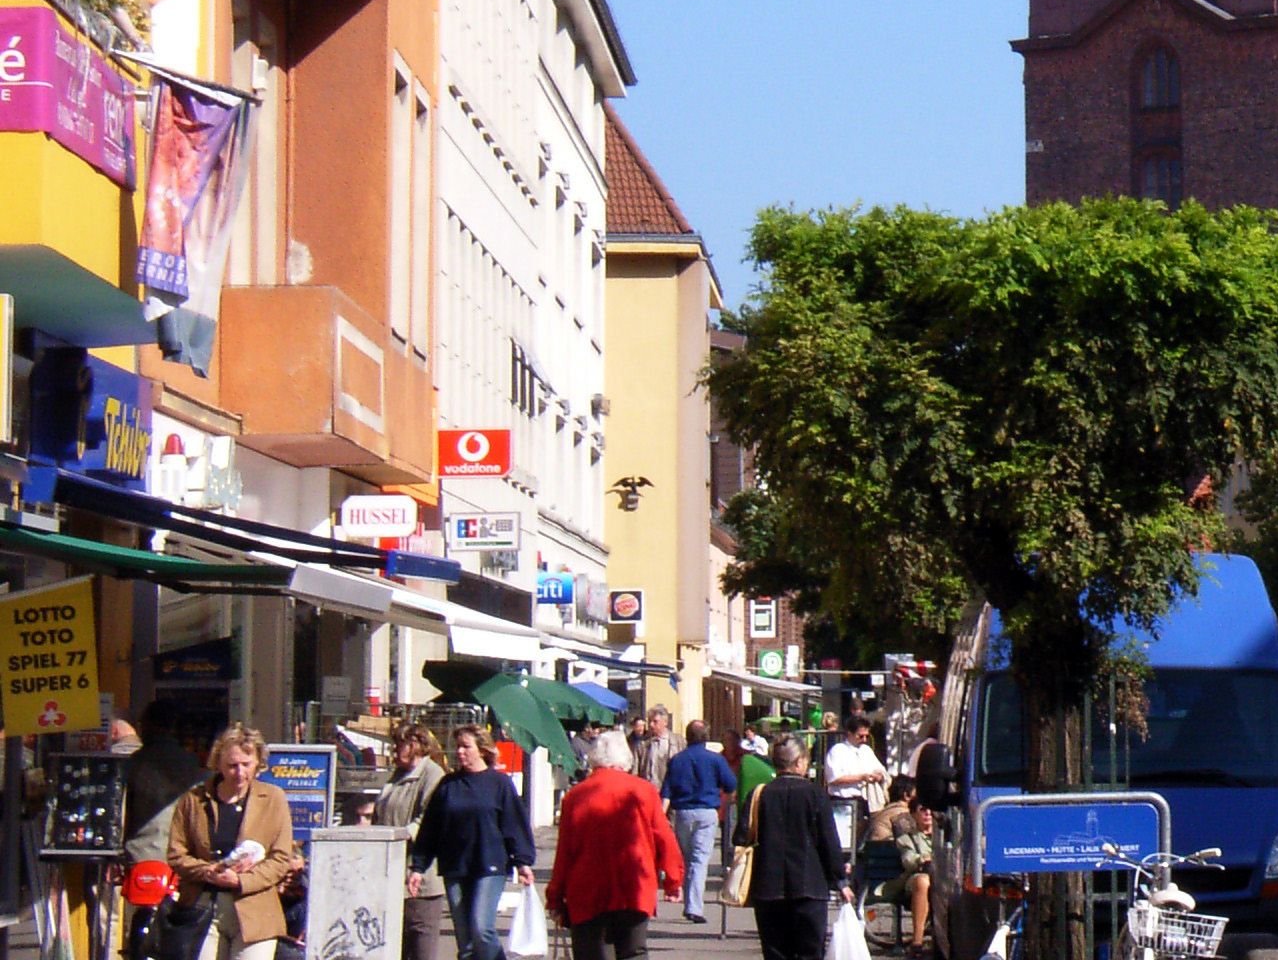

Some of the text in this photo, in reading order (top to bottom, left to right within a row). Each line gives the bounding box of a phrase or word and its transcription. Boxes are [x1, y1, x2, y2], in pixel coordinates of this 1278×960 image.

[444, 462, 502, 475] vodafone
[349, 508, 410, 526] HUSSEL
[537, 581, 562, 598] citi
[14, 605, 76, 625] LOTTO
[20, 628, 74, 647] TOTO
[8, 651, 87, 671] SPIEL 77
[10, 674, 90, 694] SUPER 6
[271, 765, 325, 778] Tchibo
